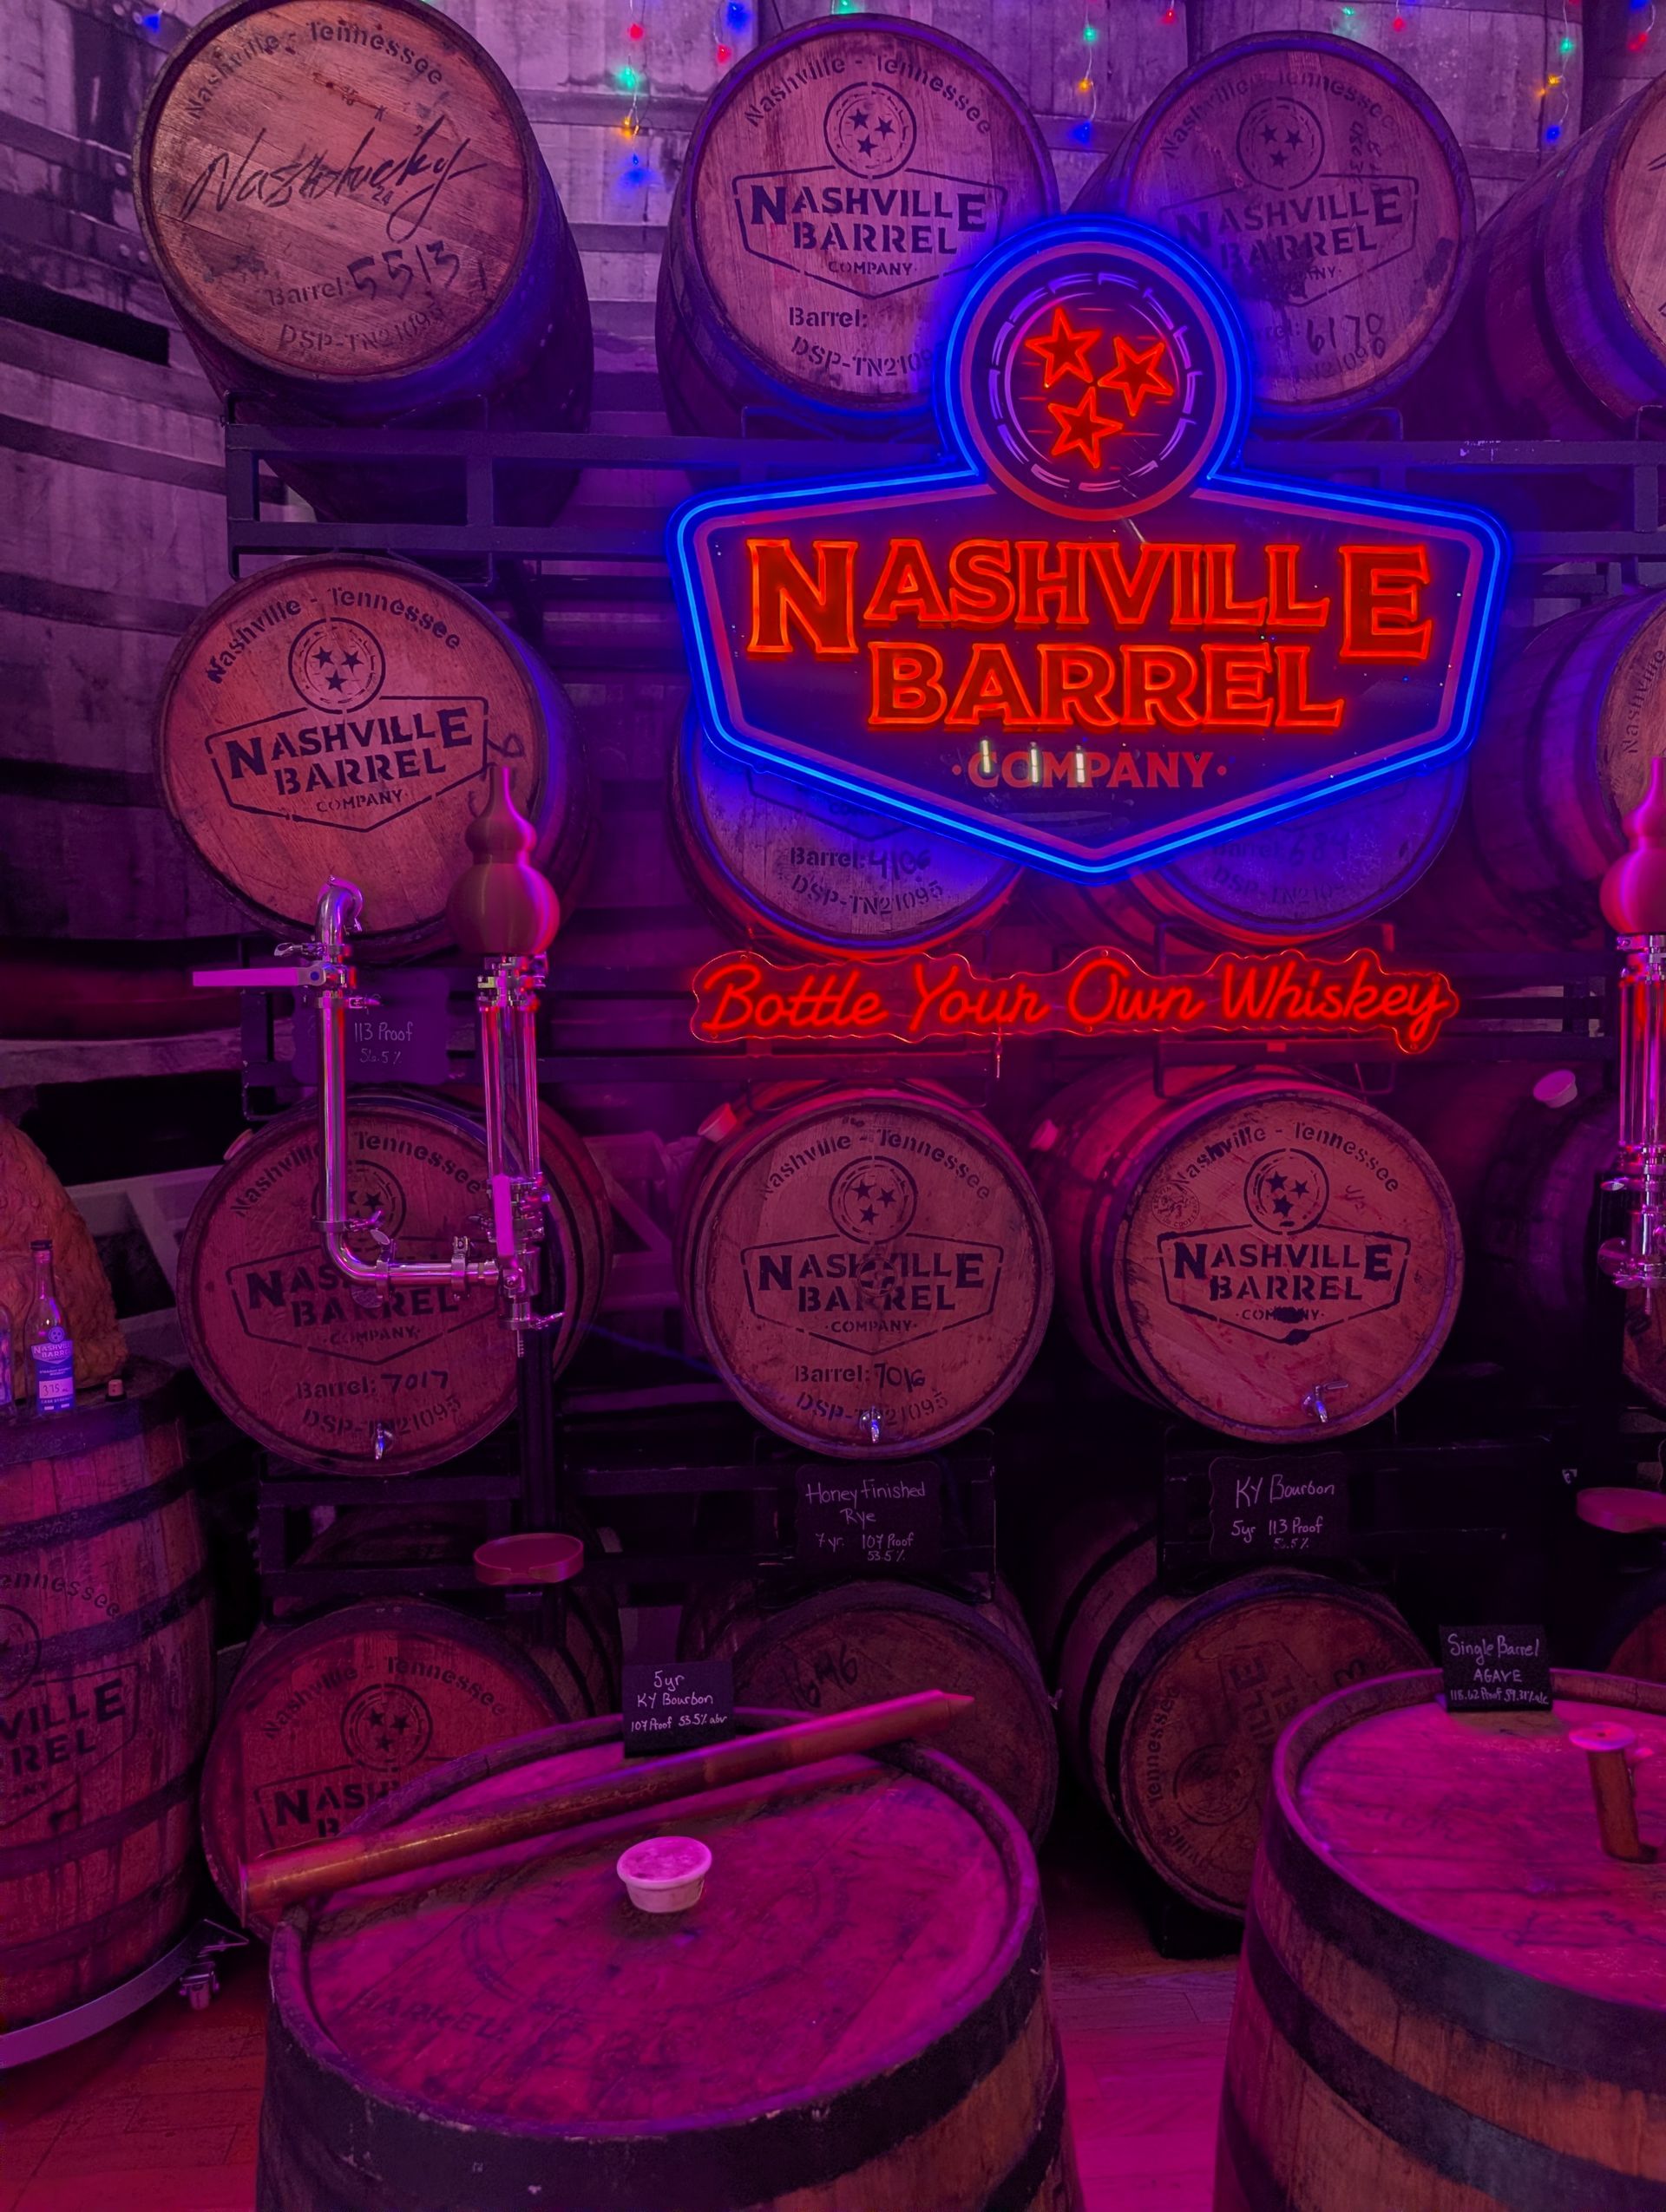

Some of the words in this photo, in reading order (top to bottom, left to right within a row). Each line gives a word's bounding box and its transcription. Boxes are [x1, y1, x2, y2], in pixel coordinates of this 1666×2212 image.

[309, 20, 443, 85] Tennessee
[744, 55, 847, 128] Nashville
[874, 54, 993, 135] Tennessee
[751, 184, 989, 234] NASHVILLE
[1176, 185, 1404, 250] NASHVILLE
[792, 222, 958, 255] BARREL
[1220, 225, 1378, 271] BARREL
[828, 260, 914, 277] COMPANY
[788, 305, 868, 329] Barrel:
[790, 335, 934, 377] DSP-TN2109
[746, 538, 1433, 662] NASHVILLE
[206, 597, 302, 684] Nashville
[327, 586, 461, 650] Tennessee
[868, 641, 1345, 733] BARREL
[225, 707, 474, 780] NASHVILLE
[273, 747, 446, 795] BARREL
[967, 749, 1213, 789] COMPANY
[317, 789, 403, 813] COMPANY
[790, 847, 865, 869] Barrel:
[791, 874, 943, 915] DSP-TN21095
[701, 959, 887, 1032] Bottle
[908, 964, 1051, 1032] Your
[1067, 957, 1206, 1025] Own
[1221, 956, 1453, 1039] Whiskey
[378, 1021, 414, 1042] Proof
[230, 1144, 320, 1218] Nashvill
[354, 1130, 482, 1194] Tennessee
[878, 1129, 990, 1200] Tennessee
[1175, 1126, 1266, 1190] Nashville
[1295, 1122, 1399, 1193] Tennessee
[1173, 1241, 1393, 1281] NASHVILLE
[797, 1285, 955, 1312] BAREL
[1209, 1275, 1362, 1301] BARREL
[830, 1319, 913, 1333] COMPANY
[1242, 1306, 1319, 1324] COMNY
[33, 1344, 70, 1355] NASHVILL
[330, 1325, 416, 1345] COMPANY
[41, 1349, 69, 1359] BARRE
[296, 1378, 376, 1399] Barrel:
[381, 1371, 449, 1394] 7017
[795, 1365, 869, 1383] Barrel:
[875, 1363, 926, 1393] 7016
[805, 1482, 857, 1509] Honey
[860, 1478, 927, 1500] Finished
[1236, 1476, 1263, 1509] KY
[1269, 1473, 1335, 1504] Bourbon
[839, 1508, 876, 1530] Rye
[1230, 1519, 1257, 1544] 5yr
[1268, 1518, 1289, 1536] 113
[1292, 1515, 1324, 1535] Proof
[862, 1533, 884, 1550] 107
[887, 1531, 915, 1549] Proof
[0, 1571, 121, 1618] ennessee
[1447, 1633, 1495, 1666] Single
[1496, 1634, 1540, 1659] Barrel
[1473, 1667, 1523, 1684] AGAVE
[0, 1679, 126, 1741] VILLE
[262, 1666, 358, 1739] Nashville
[388, 1656, 508, 1717] Tennessee
[636, 1692, 658, 1710] KY
[662, 1691, 714, 1706] Bourbon
[1480, 1686, 1502, 1701] Proof
[649, 1715, 673, 1731] Proof
[709, 1713, 728, 1725] abv
[11, 1729, 96, 1776] REL
